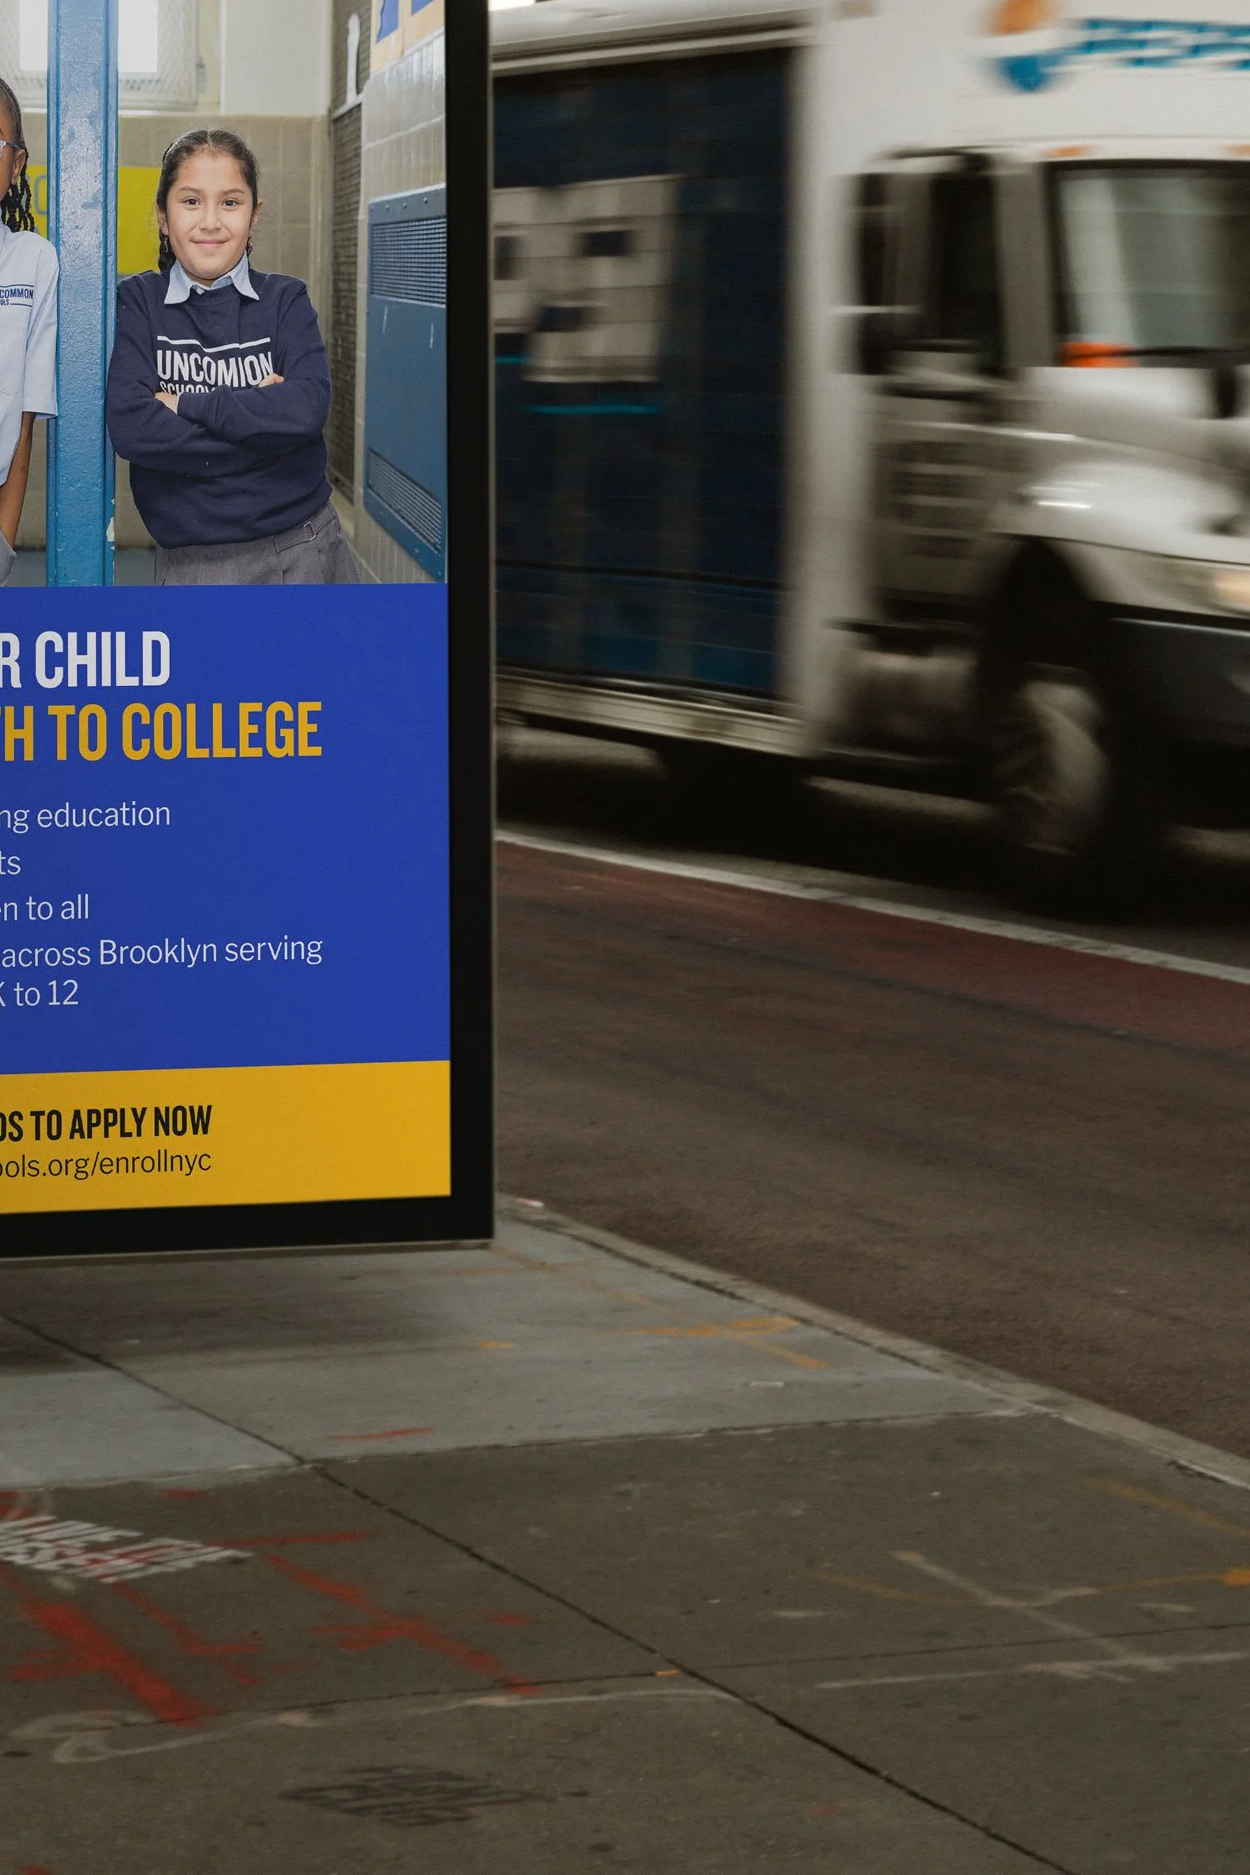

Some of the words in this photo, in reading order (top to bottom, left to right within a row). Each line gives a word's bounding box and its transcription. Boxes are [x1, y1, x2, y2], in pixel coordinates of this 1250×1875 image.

[35, 630, 171, 689] CHILD
[47, 703, 108, 762] TO
[121, 700, 323, 761] COLLEGE
[37, 800, 171, 828] education
[25, 895, 54, 921] to
[60, 893, 89, 920] all
[1, 946, 91, 968] across
[99, 937, 217, 969] Brooklyn
[224, 934, 324, 965] serving
[13, 981, 41, 1007] to
[48, 979, 79, 1006] 12
[29, 1109, 62, 1141] TO
[69, 1107, 148, 1139] APPLY
[154, 1104, 213, 1137] NOW
